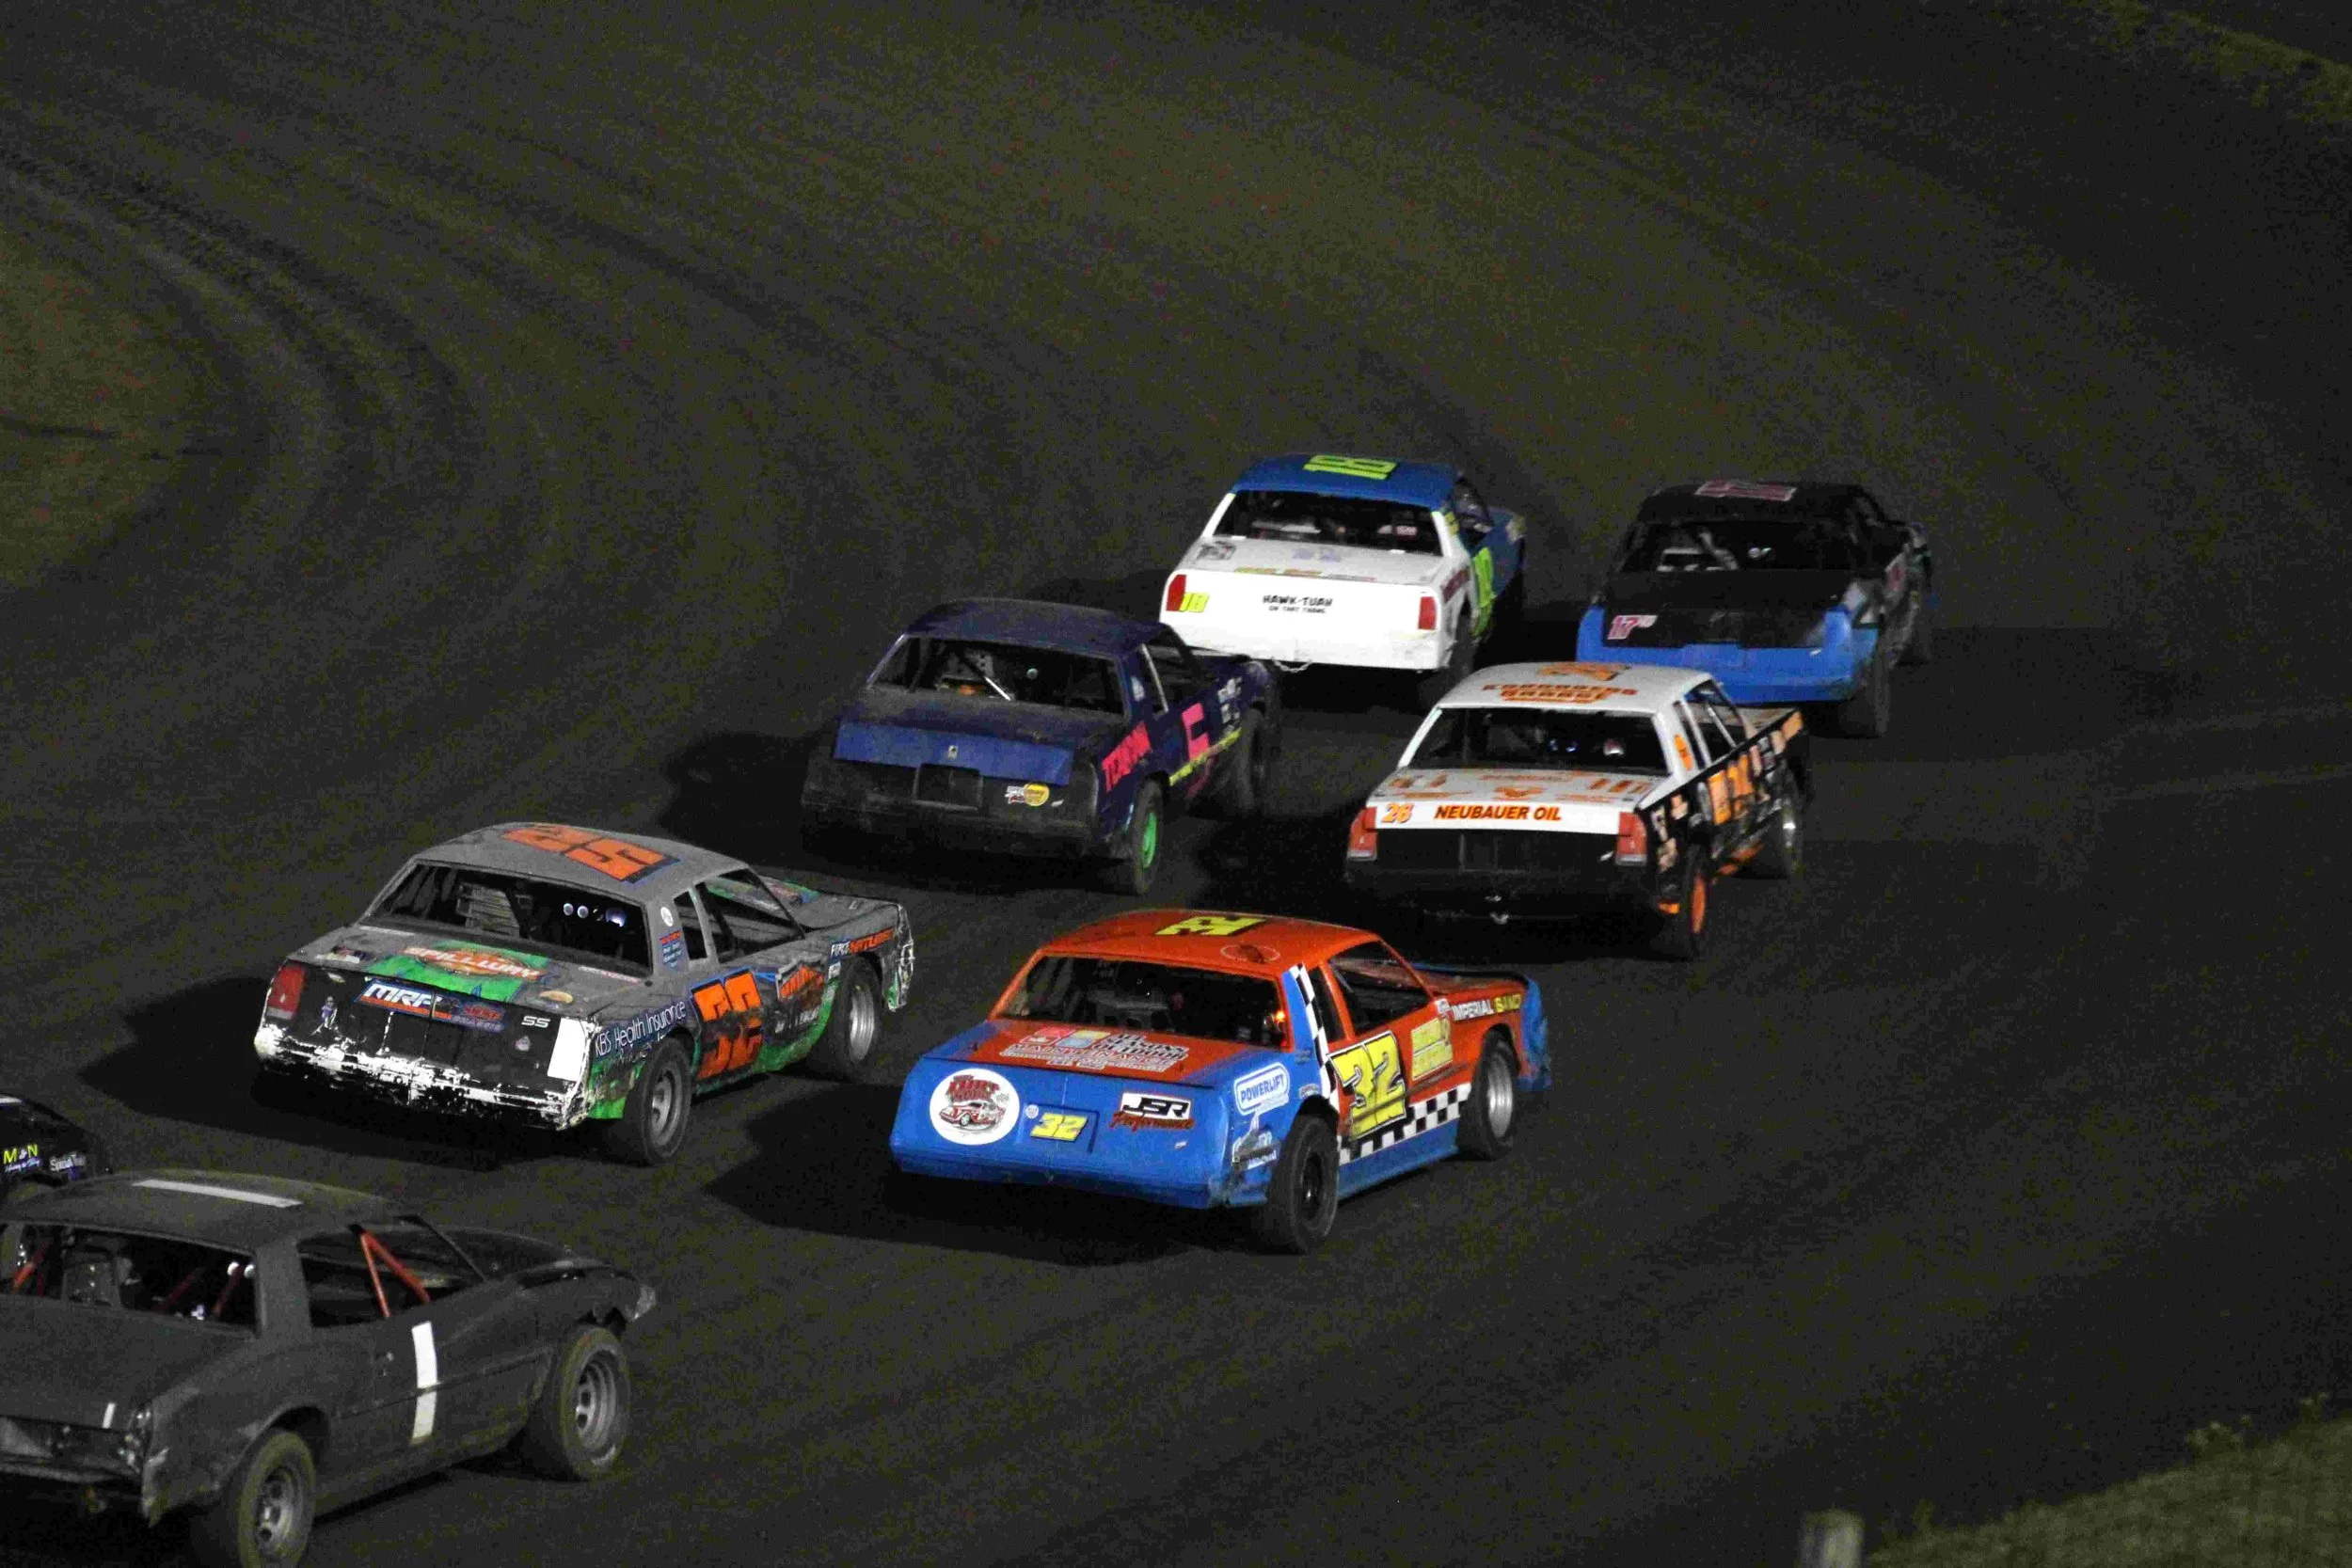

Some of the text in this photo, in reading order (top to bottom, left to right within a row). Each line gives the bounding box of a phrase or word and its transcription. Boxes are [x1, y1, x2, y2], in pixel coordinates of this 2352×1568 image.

[1434, 805, 1563, 821] NEUBAUER OIL
[403, 947, 542, 978] SPILLWAY
[521, 1015, 550, 1028] SS
[1451, 999, 1494, 1022] IMPERIAL
[596, 1031, 612, 1057] KBS
[614, 1018, 645, 1049] Health
[646, 1001, 687, 1034] Insurance
[1240, 1074, 1285, 1103] POWERLIFT
[1326, 1030, 1406, 1140] 32
[1122, 1097, 1189, 1117] JSR
[1030, 1113, 1089, 1141] 32
